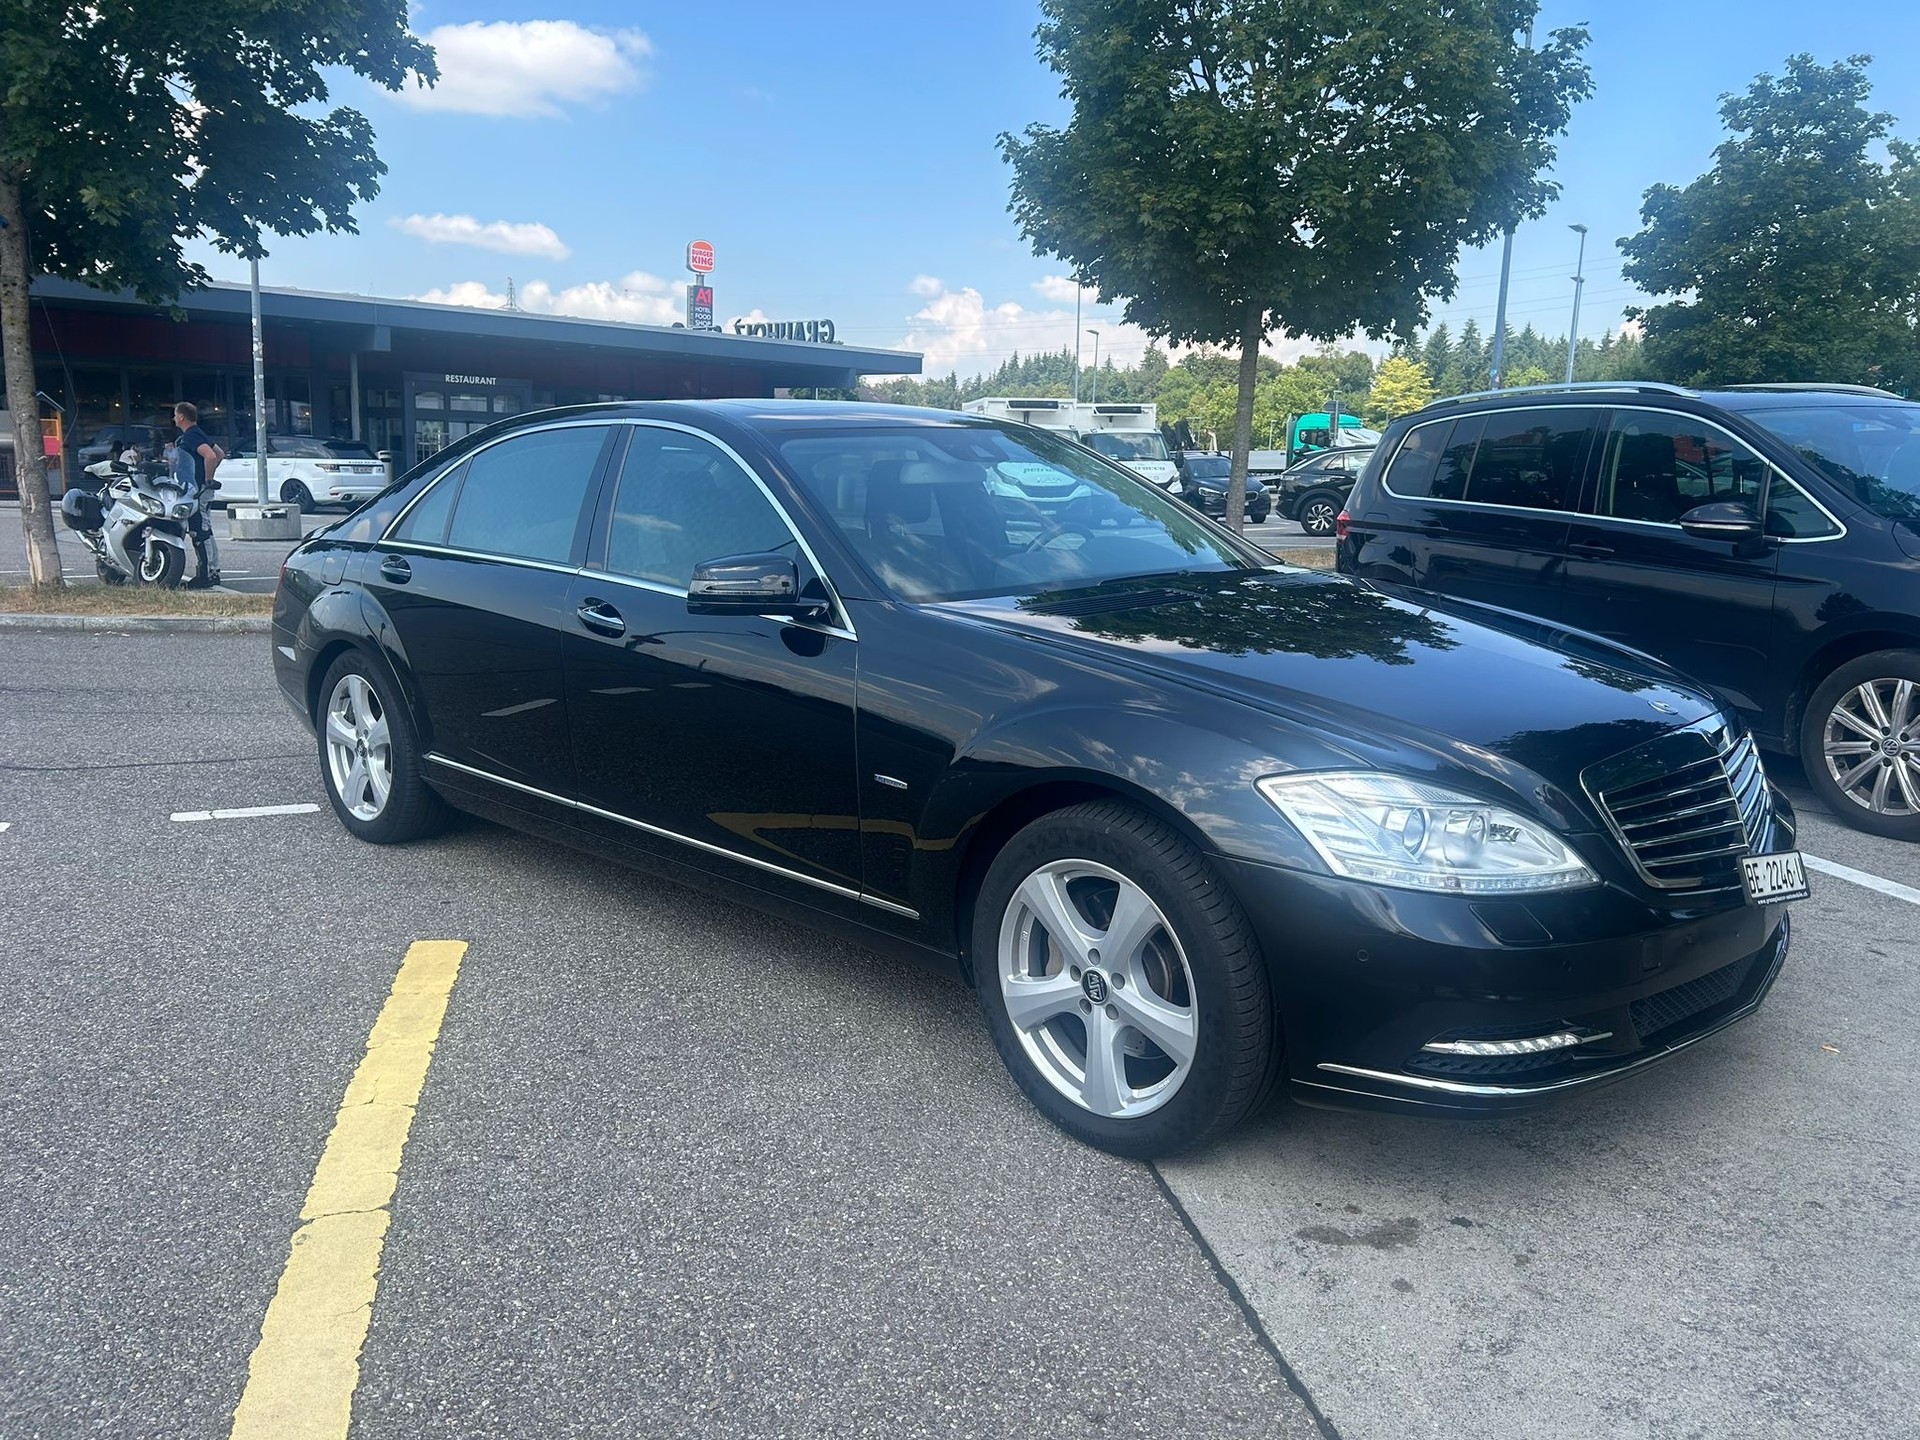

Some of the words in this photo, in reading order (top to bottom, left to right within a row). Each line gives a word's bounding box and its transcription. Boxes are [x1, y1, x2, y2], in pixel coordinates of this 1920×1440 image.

[692, 249, 713, 257] BURGER
[692, 255, 713, 266] KING
[695, 288, 711, 304] A1
[695, 319, 711, 327] SHOP
[445, 374, 497, 385] RESTAURANT
